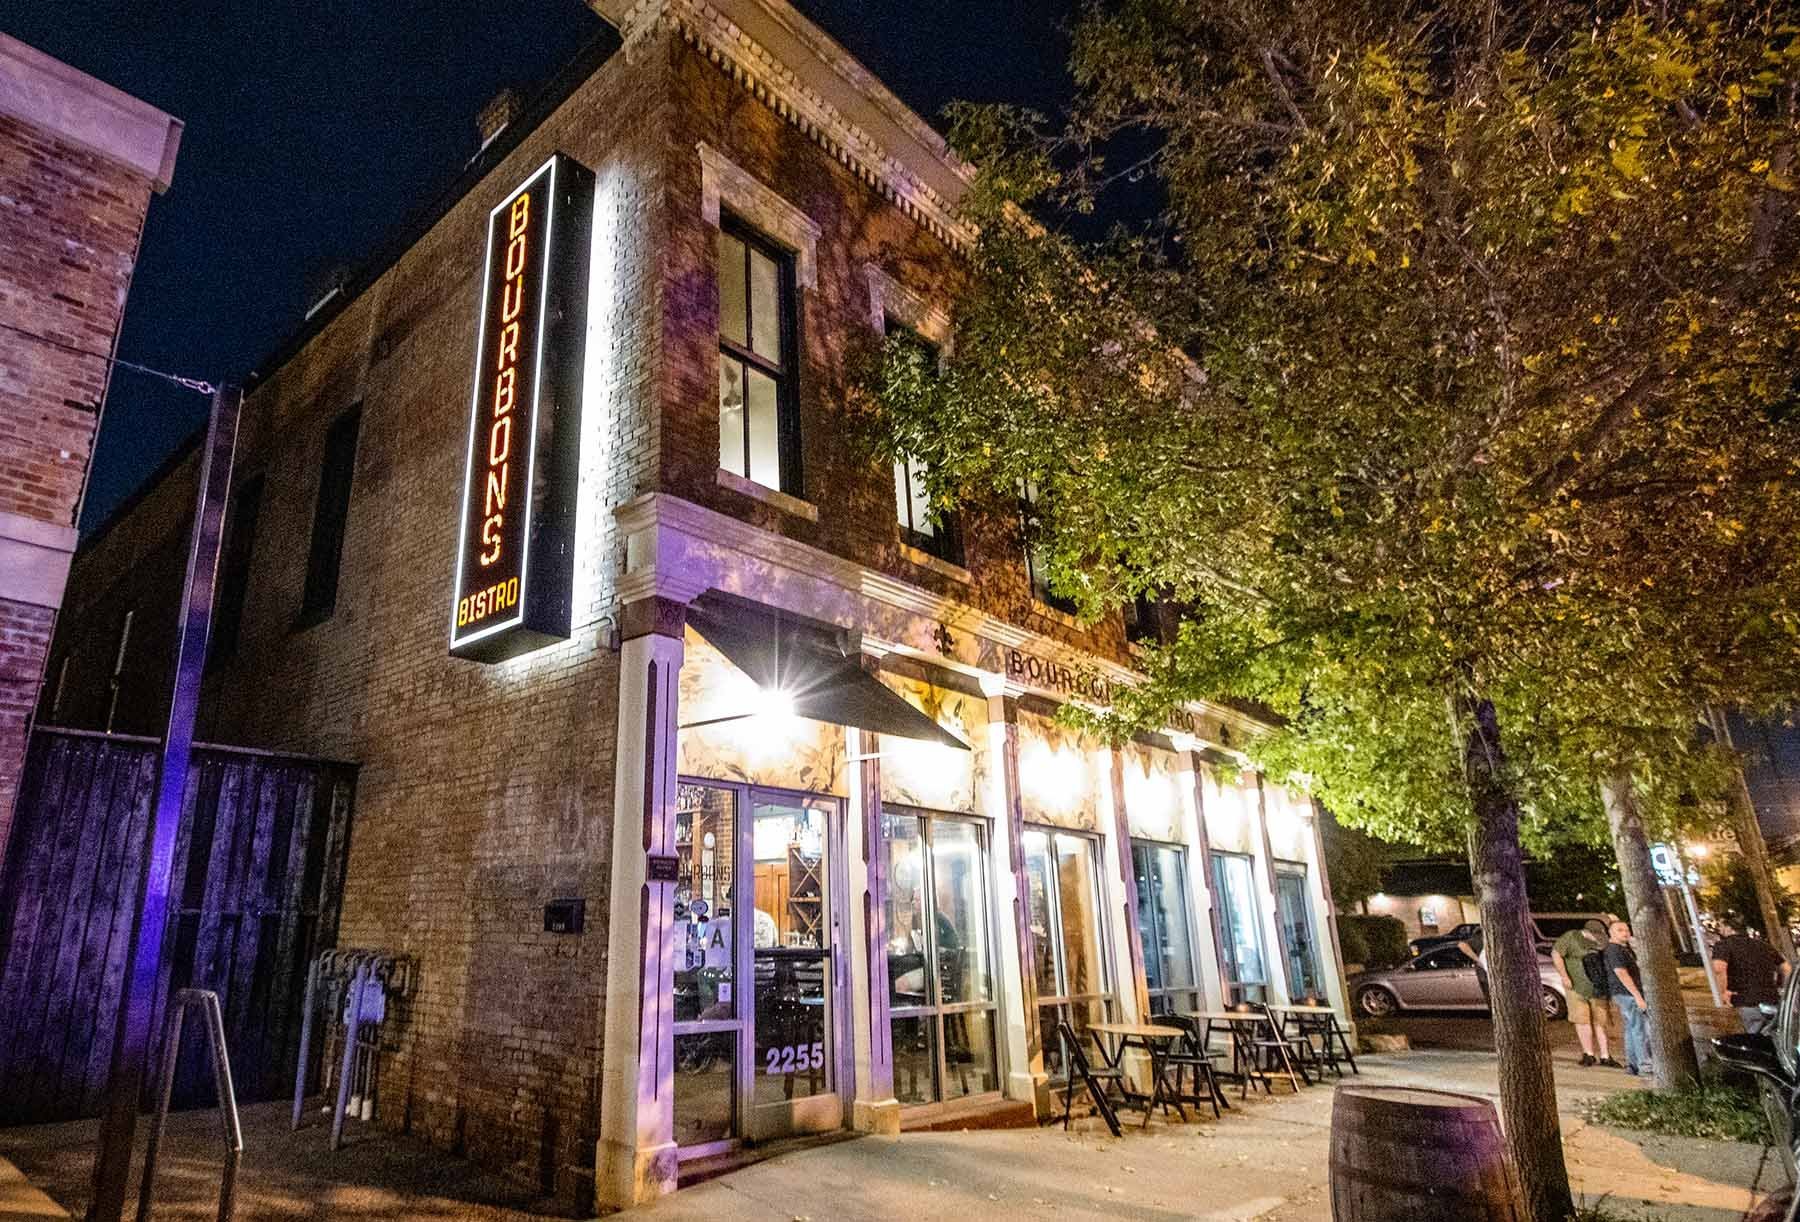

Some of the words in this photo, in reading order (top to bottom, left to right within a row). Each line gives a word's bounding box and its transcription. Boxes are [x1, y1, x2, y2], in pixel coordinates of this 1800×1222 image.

[480, 192, 530, 566] BOURBONS
[458, 577, 518, 627] BISTRO
[710, 928, 725, 949] A
[766, 1042, 824, 1075] 2255
